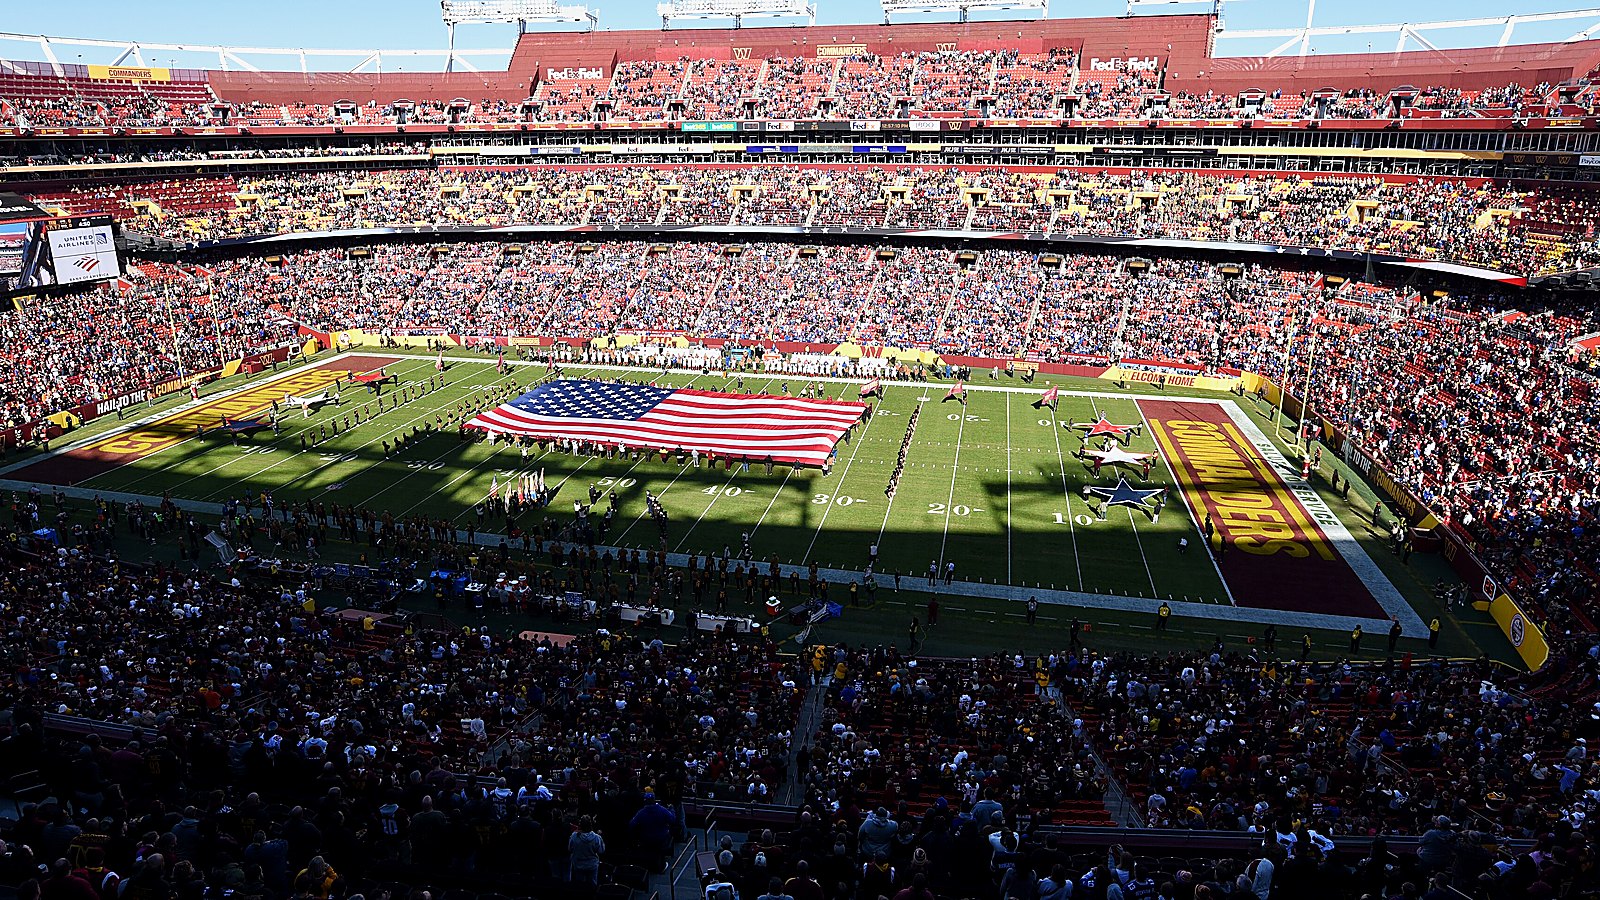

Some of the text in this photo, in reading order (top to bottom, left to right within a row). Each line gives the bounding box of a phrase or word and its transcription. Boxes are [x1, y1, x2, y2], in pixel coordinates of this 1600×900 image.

[816, 46, 868, 56] COMMANDERS
[1090, 56, 1158, 71] FedExField
[108, 69, 152, 78] COMMANDERS
[546, 67, 604, 80] FedExField
[767, 122, 790, 130] FedEx
[852, 122, 875, 130] FedEx
[57, 240, 95, 249] AIRLINES
[63, 234, 94, 242] UNITED
[1168, 377, 1196, 387] HOME
[97, 399, 117, 415] HAIL
[118, 394, 130, 407] TO
[130, 390, 146, 403] THE
[100, 369, 349, 454] COMMANDERS
[597, 477, 637, 488] 50
[1166, 419, 1311, 558] COMMANDERS
[701, 485, 743, 497] 40
[1376, 469, 1416, 517] COMMANDERS
[811, 494, 853, 507] 30
[1291, 484, 1339, 527] SERVICE
[927, 503, 971, 516] 20
[1051, 512, 1094, 526] 10
